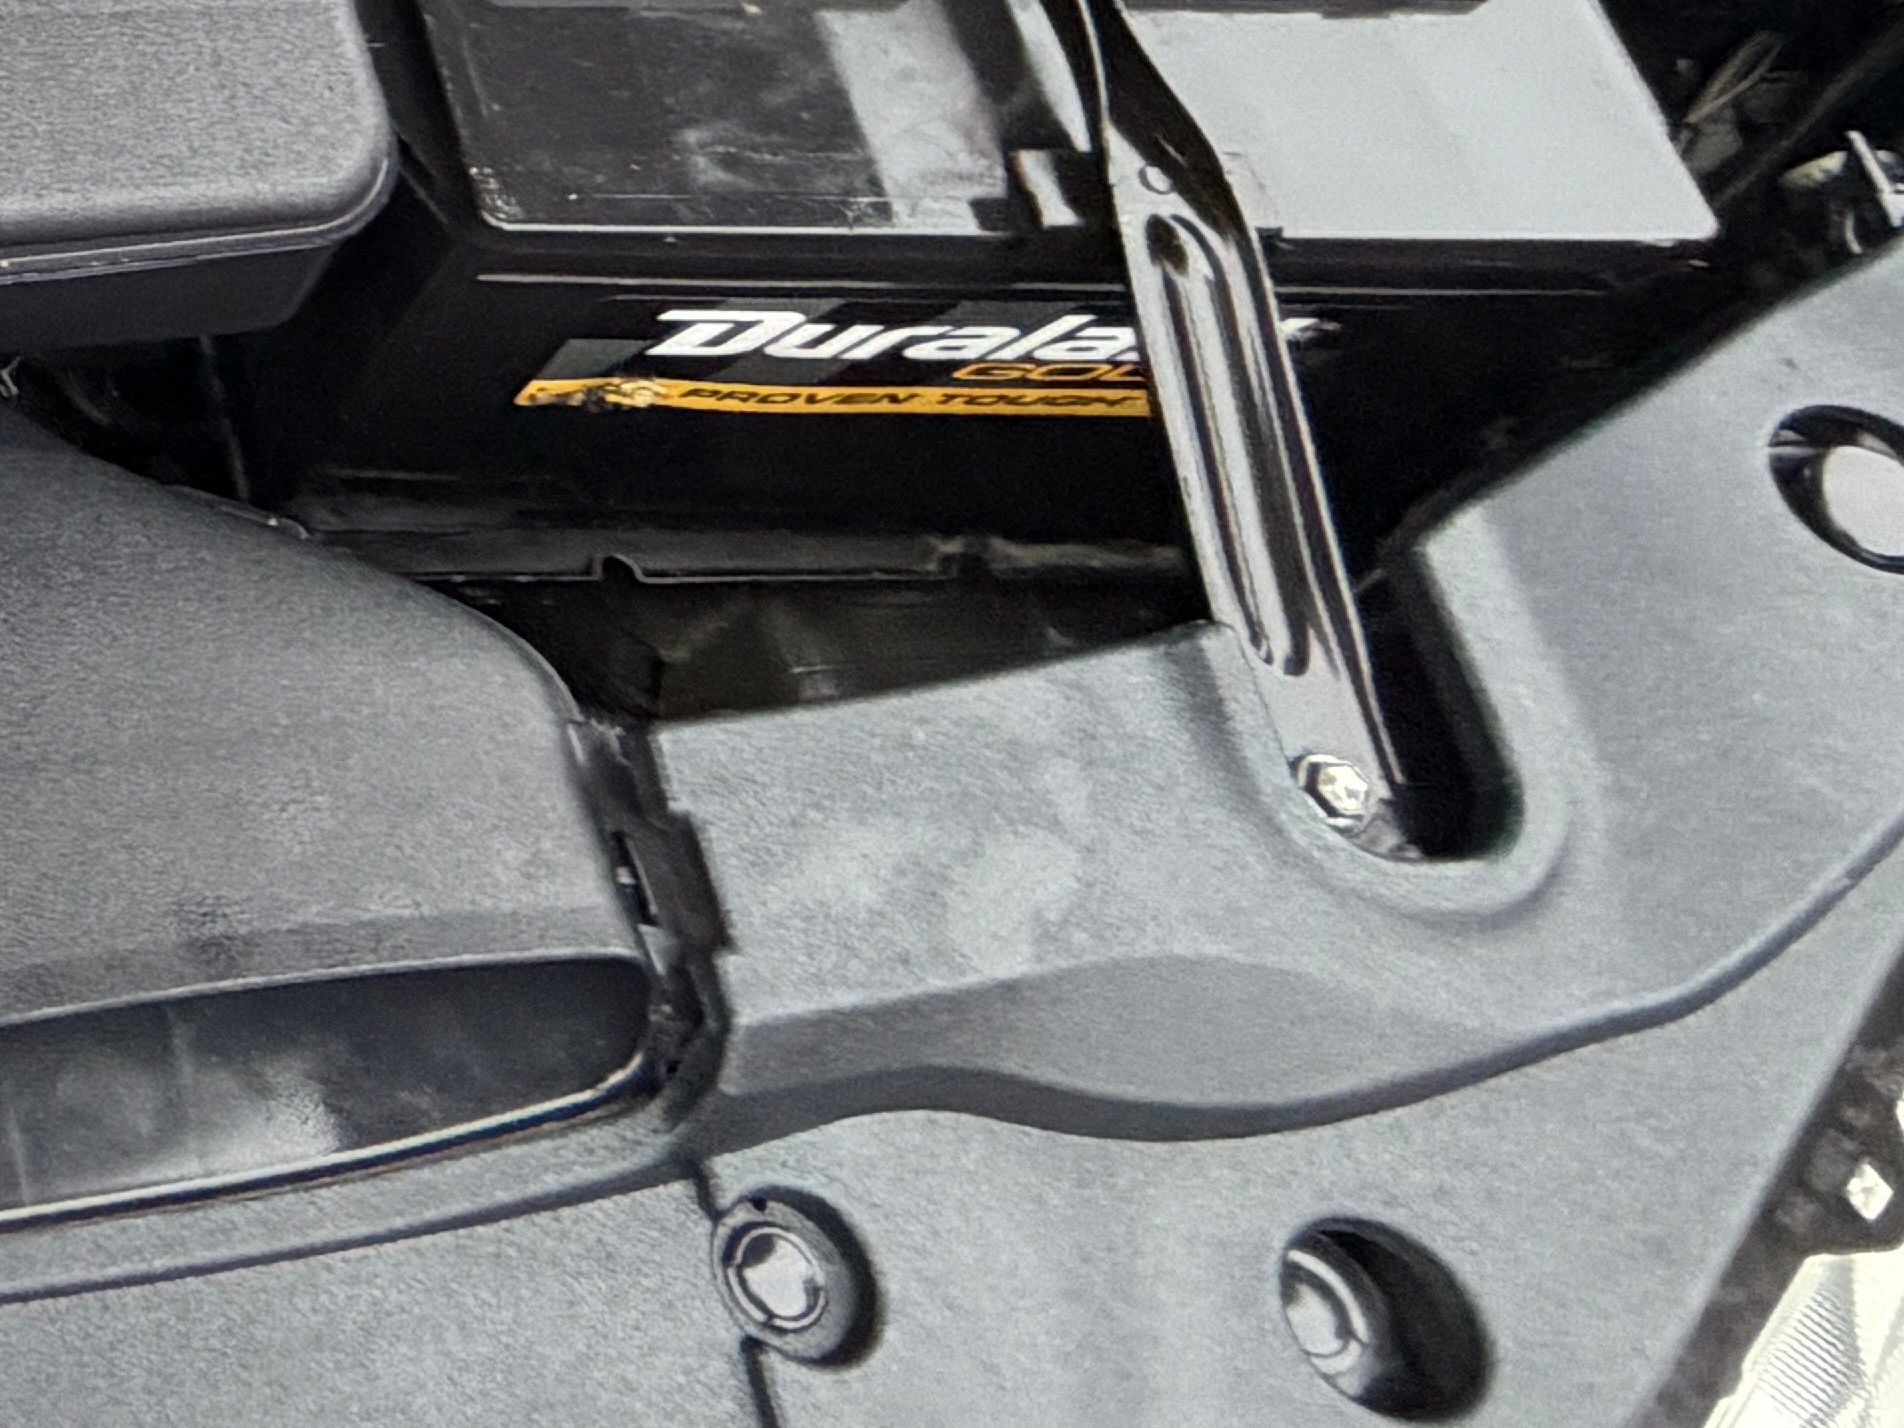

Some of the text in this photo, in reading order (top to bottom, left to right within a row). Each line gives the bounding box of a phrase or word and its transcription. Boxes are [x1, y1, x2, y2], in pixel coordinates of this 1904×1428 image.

[644, 307, 1322, 363] Durala
[952, 361, 1148, 382] GOL
[679, 388, 1140, 409] PROVEN TOUGH
